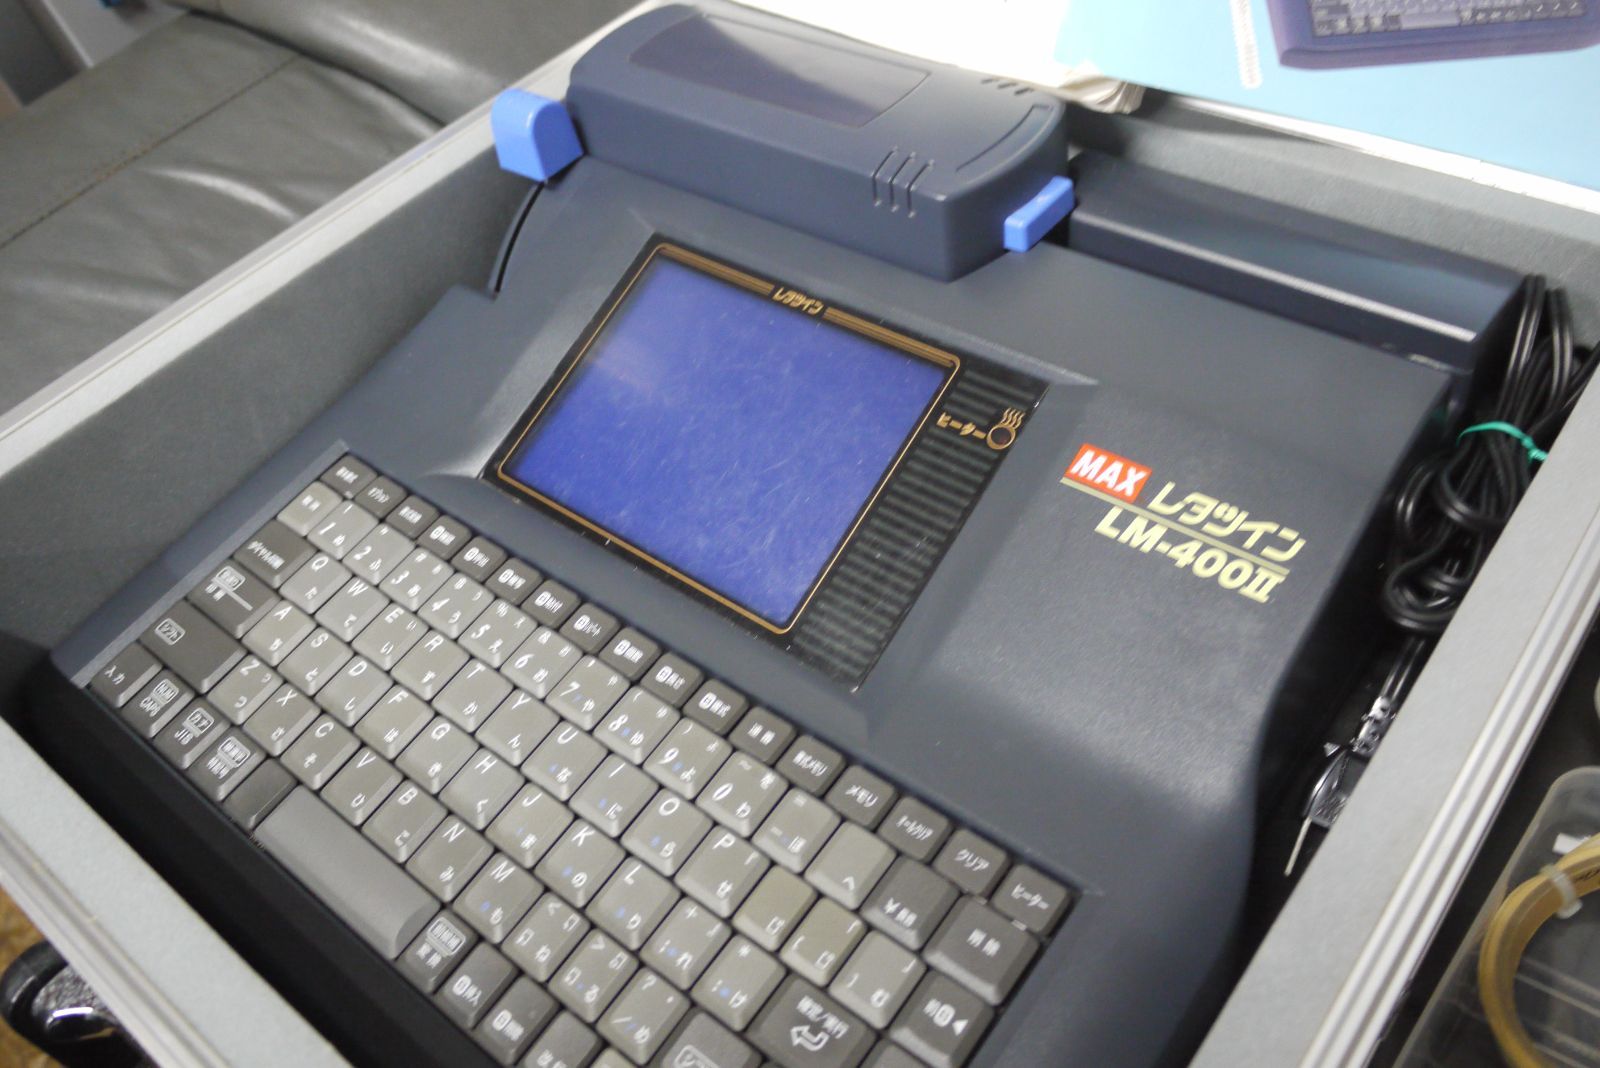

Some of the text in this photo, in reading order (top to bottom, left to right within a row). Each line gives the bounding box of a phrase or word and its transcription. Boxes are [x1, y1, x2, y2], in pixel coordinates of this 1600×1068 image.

[936, 412, 986, 439] ヒーター
[1069, 449, 1147, 497] MAX
[353, 545, 371, 560] 2
[311, 556, 329, 572] Q
[391, 570, 409, 584] 3
[347, 579, 368, 597] W
[273, 604, 293, 622] A
[384, 607, 404, 624] E
[471, 623, 491, 639] 5
[311, 632, 330, 649] S
[424, 634, 444, 652] R
[348, 660, 368, 677] D
[514, 652, 534, 669] 6
[467, 662, 486, 679] T
[276, 688, 299, 708] X
[388, 690, 409, 704] F
[560, 681, 580, 697] 7
[139, 695, 161, 718] CAPS
[511, 692, 532, 710] Y
[315, 721, 335, 739] C
[430, 722, 451, 741] G
[608, 713, 628, 732] 8
[557, 725, 579, 744] U
[356, 751, 378, 769] V
[474, 754, 498, 774] H
[657, 746, 679, 764] 9
[397, 786, 419, 806] B
[522, 792, 544, 807] J
[712, 783, 734, 801] 0
[442, 822, 467, 844] N
[571, 825, 596, 847] K
[712, 832, 737, 850] P
[955, 848, 990, 871] クリア
[490, 858, 517, 884] M
[624, 863, 643, 885] L
